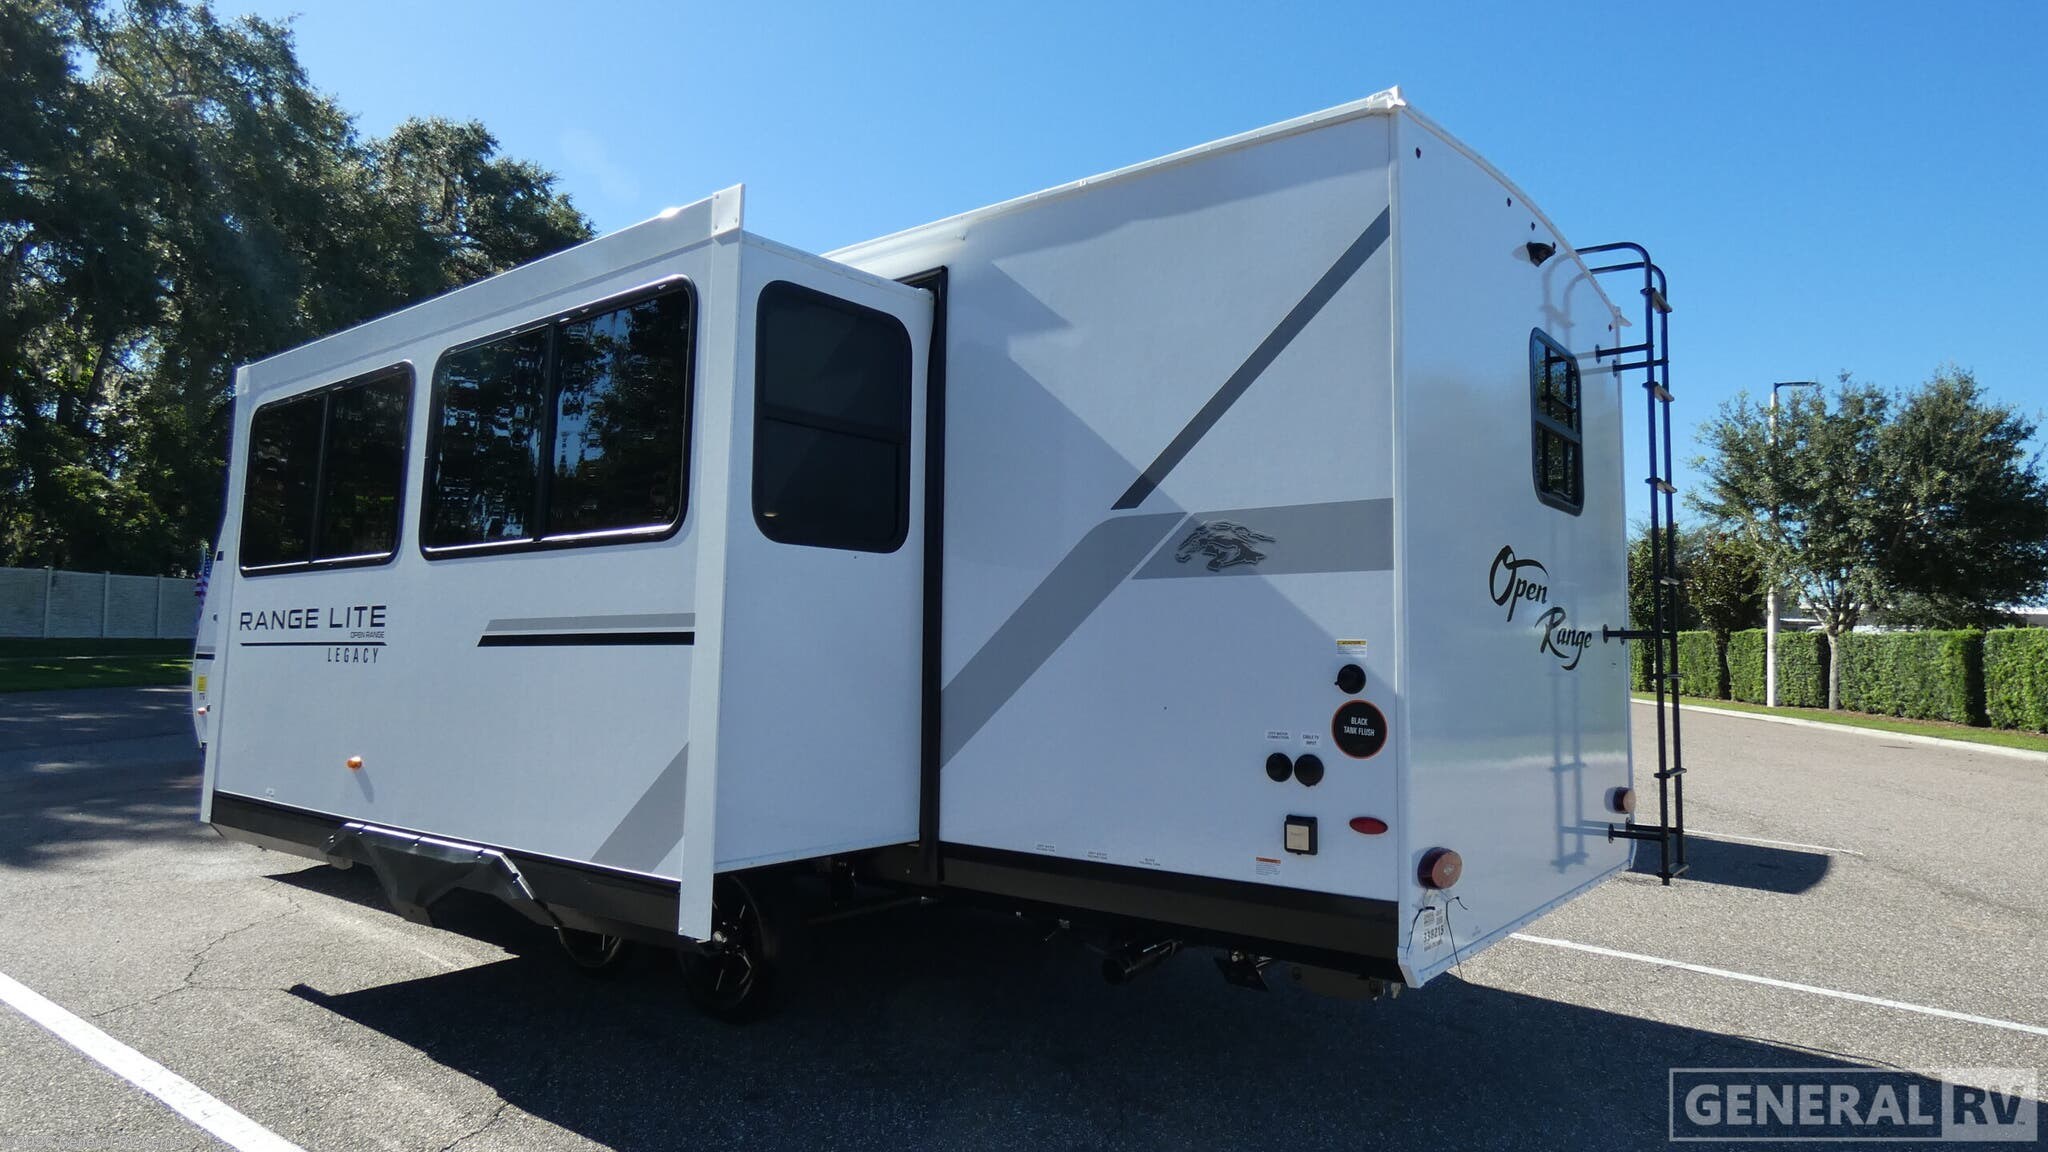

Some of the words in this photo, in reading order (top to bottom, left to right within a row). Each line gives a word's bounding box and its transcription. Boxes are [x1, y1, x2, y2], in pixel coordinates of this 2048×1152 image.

[1489, 545, 1550, 622] Open
[240, 608, 319, 631] RANGE
[329, 605, 387, 629] LITE
[350, 631, 365, 639] OPEN
[366, 631, 385, 639] RANGE
[1535, 606, 1592, 671] Range
[327, 647, 379, 664] LEGACY
[1350, 716, 1368, 726] BLACK
[1343, 725, 1357, 735] TANK
[1358, 727, 1375, 737] FLUSH
